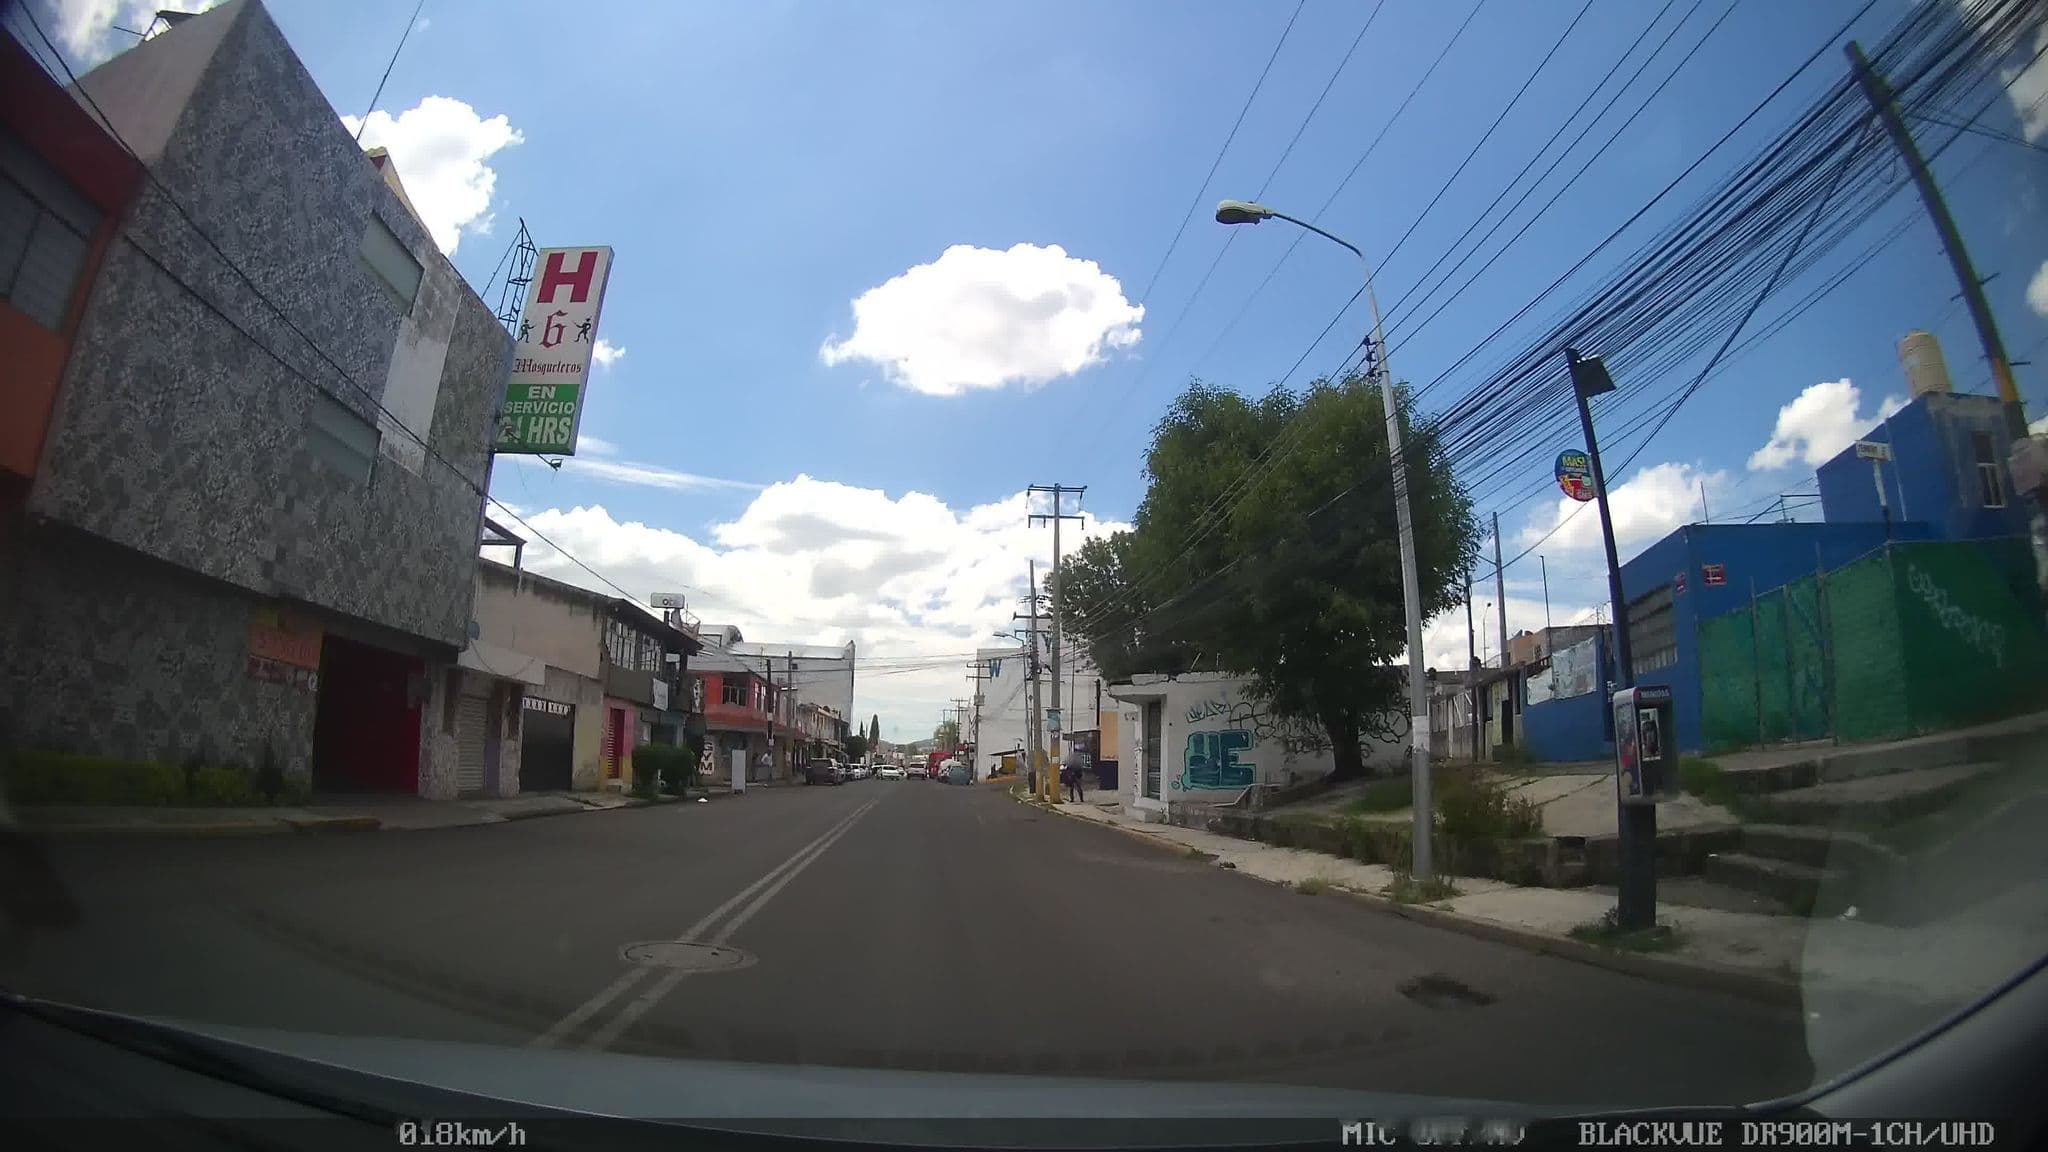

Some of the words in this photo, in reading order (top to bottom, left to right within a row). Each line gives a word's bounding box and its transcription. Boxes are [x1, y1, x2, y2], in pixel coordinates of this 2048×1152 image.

[536, 251, 598, 303] H
[512, 358, 582, 374] Mosqueteros
[528, 386, 556, 399] EN
[503, 401, 576, 414] SERVICIO
[527, 416, 571, 445] HRS
